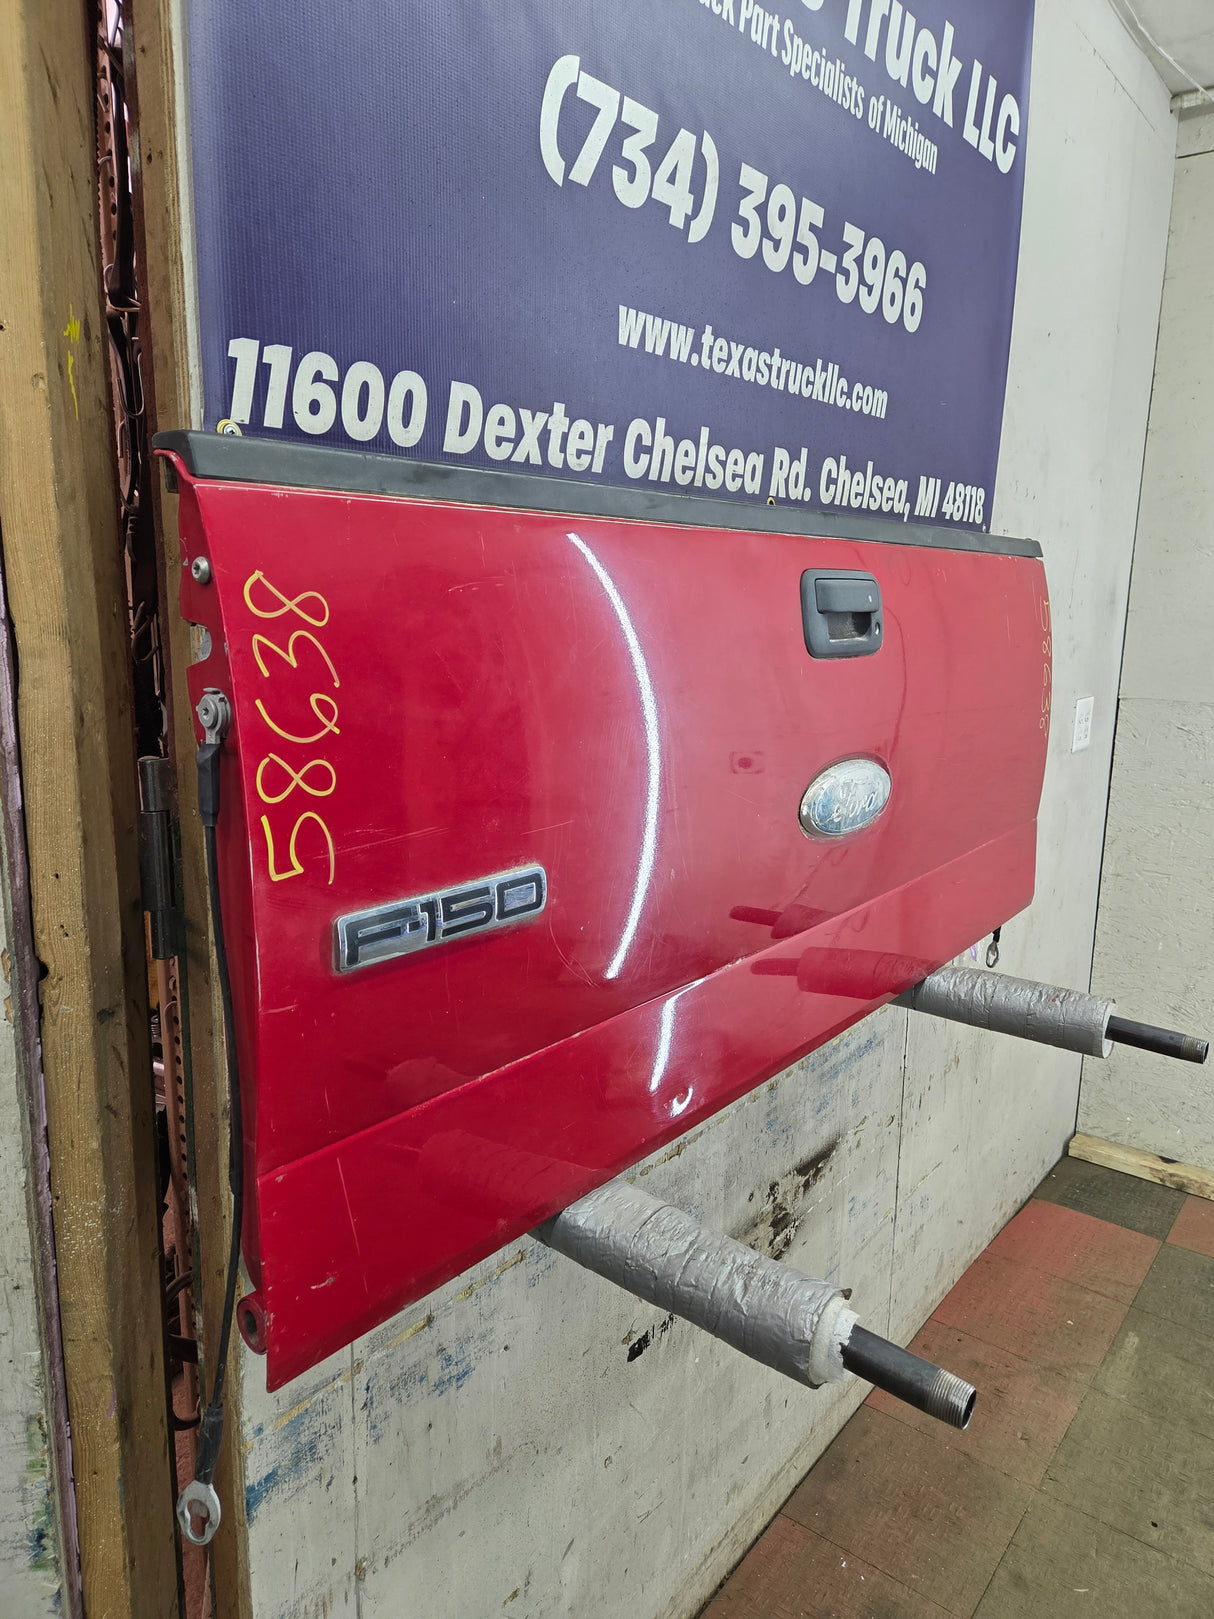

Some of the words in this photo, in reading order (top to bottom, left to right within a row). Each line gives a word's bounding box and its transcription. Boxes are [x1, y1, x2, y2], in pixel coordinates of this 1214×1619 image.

[739, 0, 780, 57] Part
[781, 18, 865, 119] Specialists
[868, 95, 885, 133] of
[883, 99, 938, 175] Michigan
[963, 58, 1020, 174] LLC
[539, 54, 719, 243] (734)
[731, 162, 927, 333] 395-3966
[227, 337, 428, 448] 11600
[443, 380, 614, 474] Dexter
[623, 416, 765, 494] Chelsea
[769, 446, 811, 502] Rd.
[819, 454, 911, 522] Chelsea,
[914, 475, 942, 518] MI
[941, 481, 986, 524] 48118
[618, 304, 888, 419] www.texastruckllc.com
[243, 569, 340, 885] 58638
[344, 869, 545, 967] F-150
